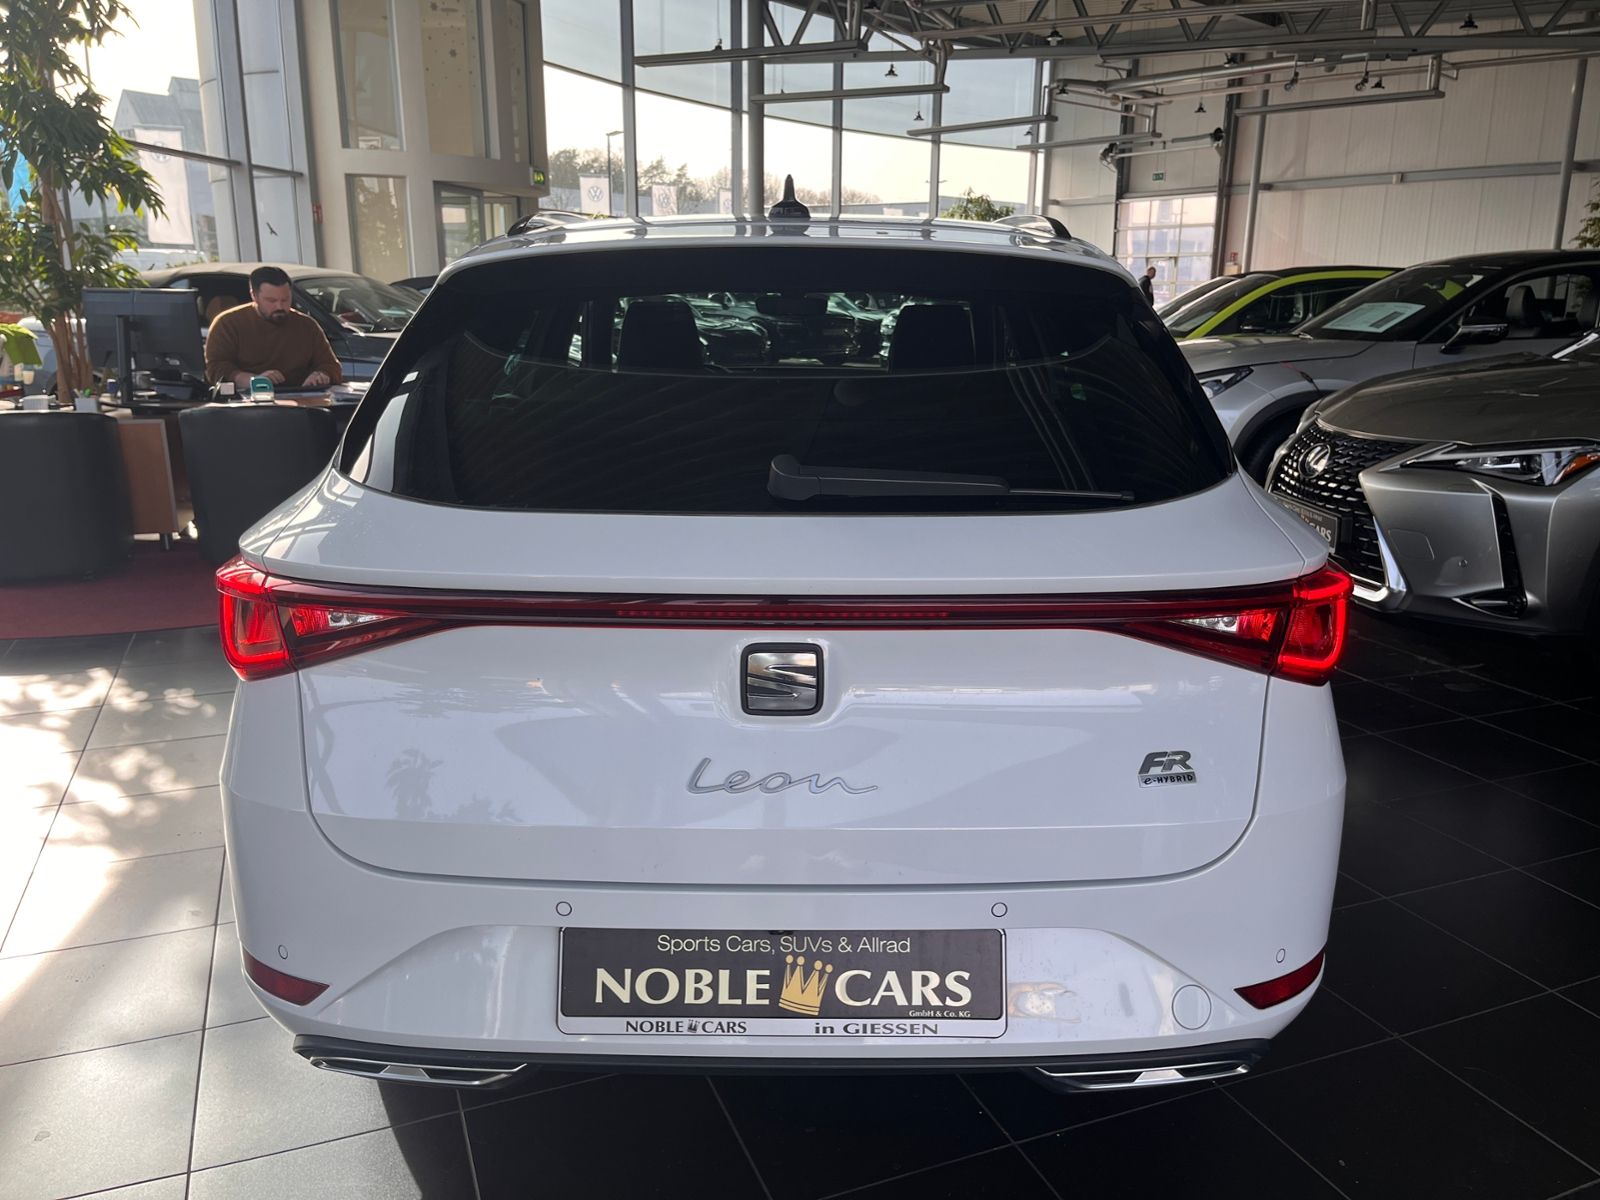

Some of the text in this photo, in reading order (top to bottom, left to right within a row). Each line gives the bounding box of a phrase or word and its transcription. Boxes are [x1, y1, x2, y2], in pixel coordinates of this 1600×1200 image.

[1138, 750, 1194, 775] FR
[686, 757, 879, 795] Leon
[1144, 774, 1193, 785] e-HYBRID
[657, 934, 911, 955] Sports Cars, SUVs & Allrad
[595, 967, 972, 1007] NOBLE CARS
[909, 1010, 971, 1018] GmbH & Co. KG
[626, 1020, 938, 1035] NOBLE CARS in GIESSEN
